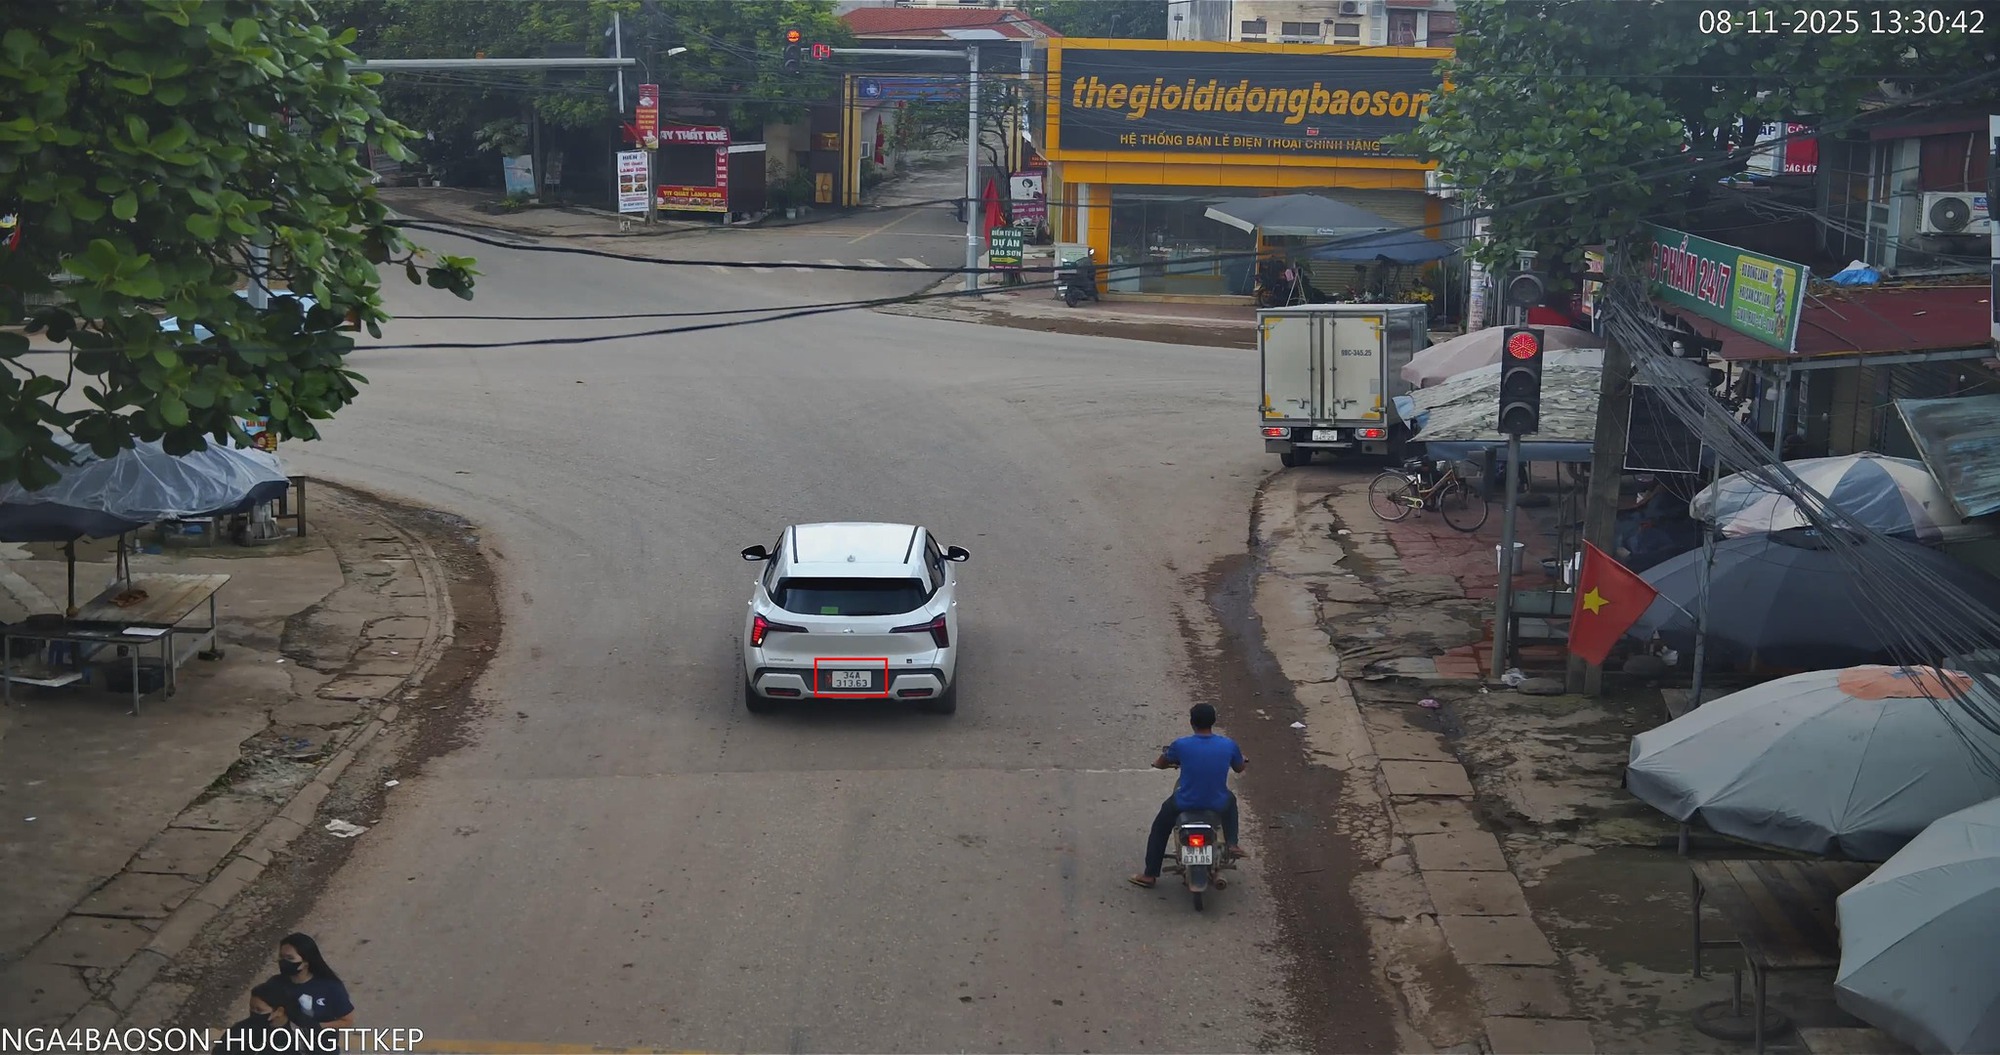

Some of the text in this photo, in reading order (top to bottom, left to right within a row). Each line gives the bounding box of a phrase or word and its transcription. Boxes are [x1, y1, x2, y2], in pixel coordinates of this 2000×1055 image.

[1072, 76, 1432, 124] thegioididongbaoson
[1120, 132, 1137, 147] HỆ
[1141, 131, 1183, 146] THỐNG
[1187, 133, 1211, 147] BÁN
[1659, 234, 1698, 297] PHẨM
[1697, 257, 1731, 309] 24/7
[843, 671, 861, 679] 34A
[836, 679, 868, 688] 313.63
[1183, 855, 1211, 864] 031.06
